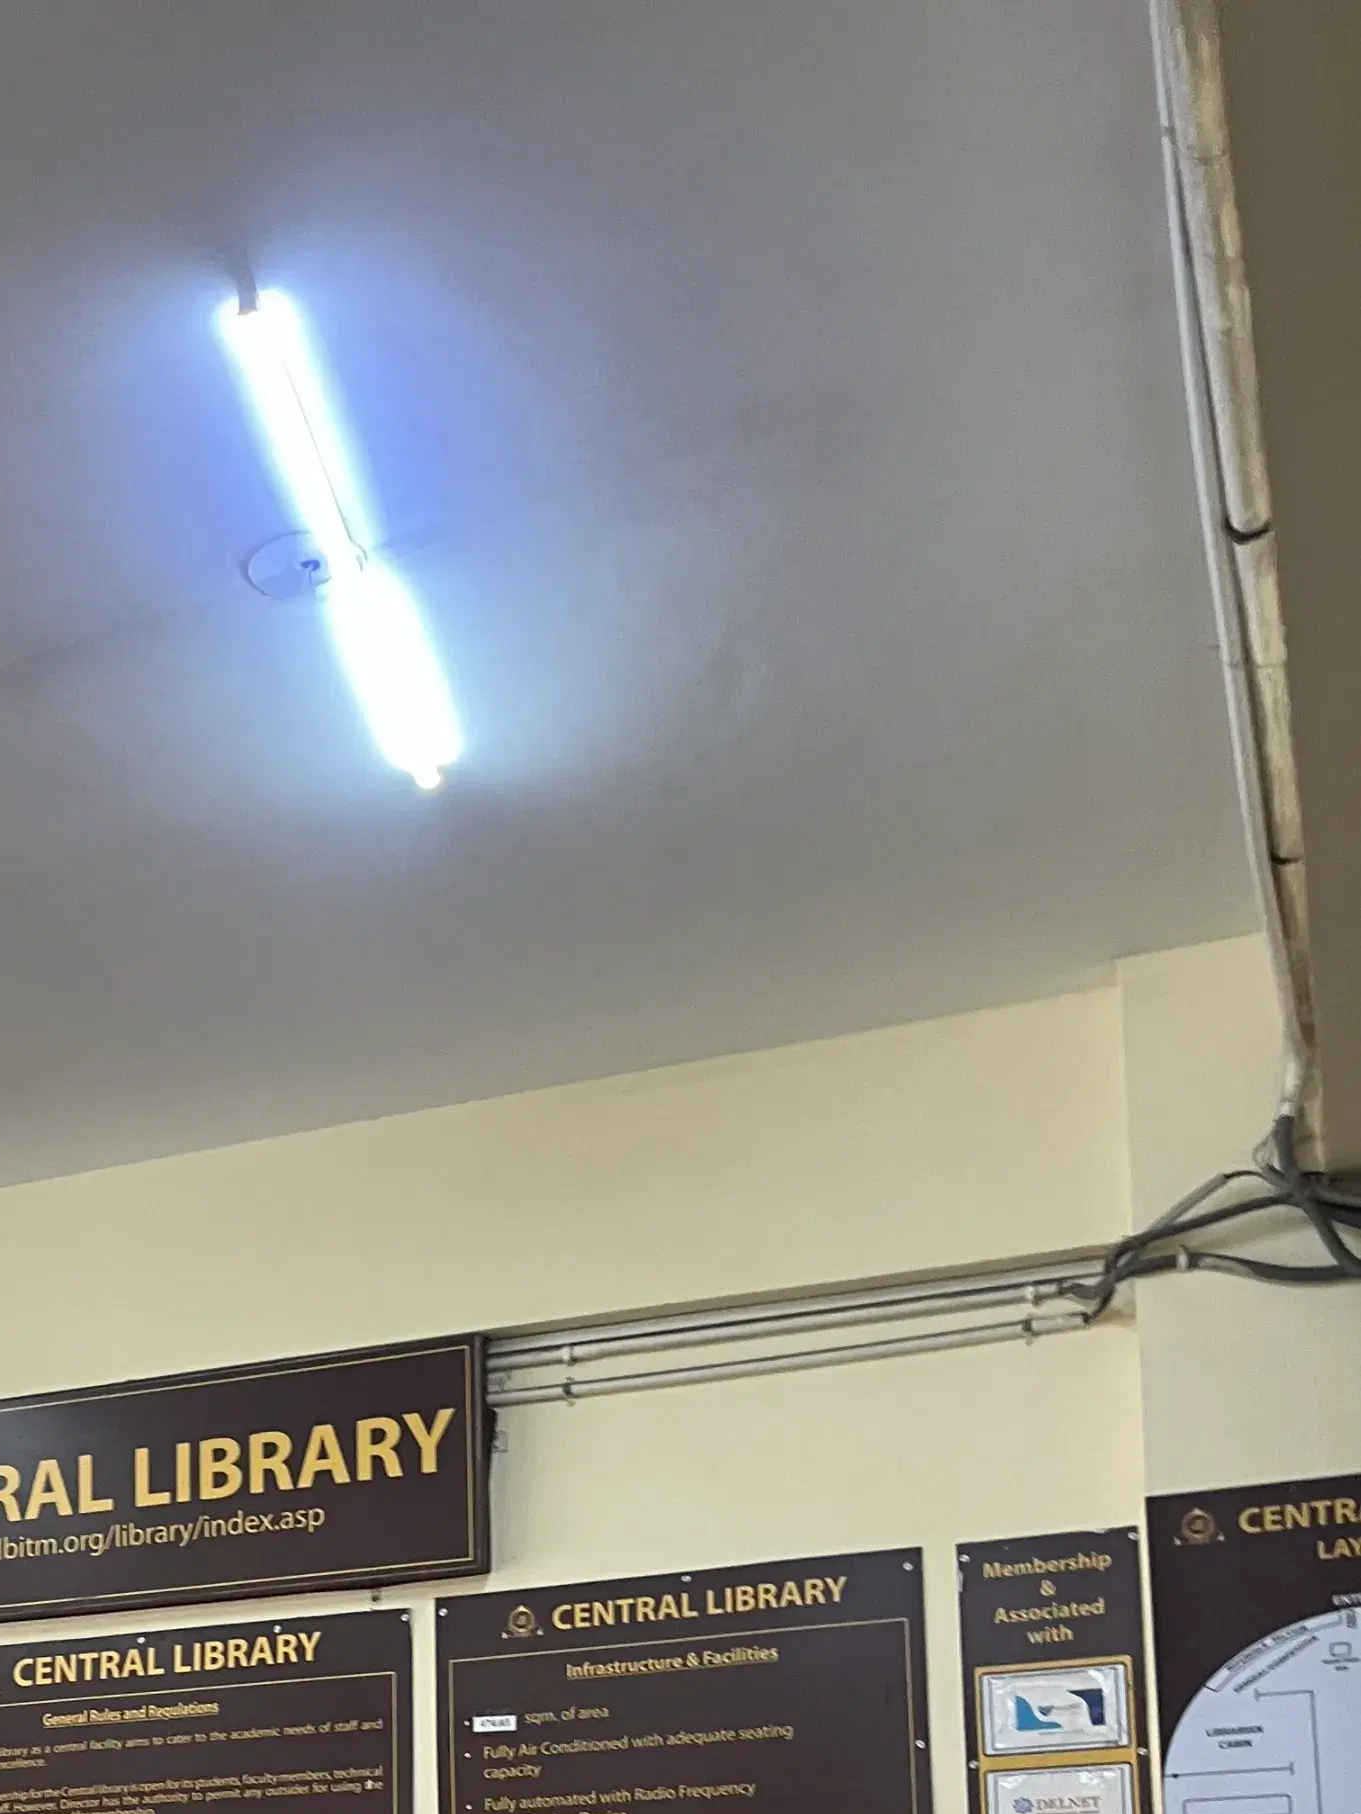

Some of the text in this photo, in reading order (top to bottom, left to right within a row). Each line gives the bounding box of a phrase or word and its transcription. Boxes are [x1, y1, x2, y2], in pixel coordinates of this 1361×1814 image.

[134, 1407, 456, 1509] LIBRARY
[1239, 1497, 1361, 1534] CENTR
[982, 1550, 1113, 1581] Membership
[552, 1575, 848, 1632] CENTRAL LIBRARY
[1040, 1580, 1057, 1597] &
[992, 1597, 1107, 1626] Associated
[1026, 1624, 1075, 1646] with
[13, 1631, 322, 1688] CENTRAL LIBRARY
[566, 1645, 779, 1679] Infrastructure & Facilities
[42, 1702, 219, 1727] General Rules and Regulations
[560, 1706, 576, 1721] of
[578, 1707, 610, 1718] area
[483, 1724, 794, 1760] Fully Air Conditioned with adequate seating
[483, 1763, 542, 1779] capacity
[484, 1782, 756, 1813] Fully automated with Radio Frequency
